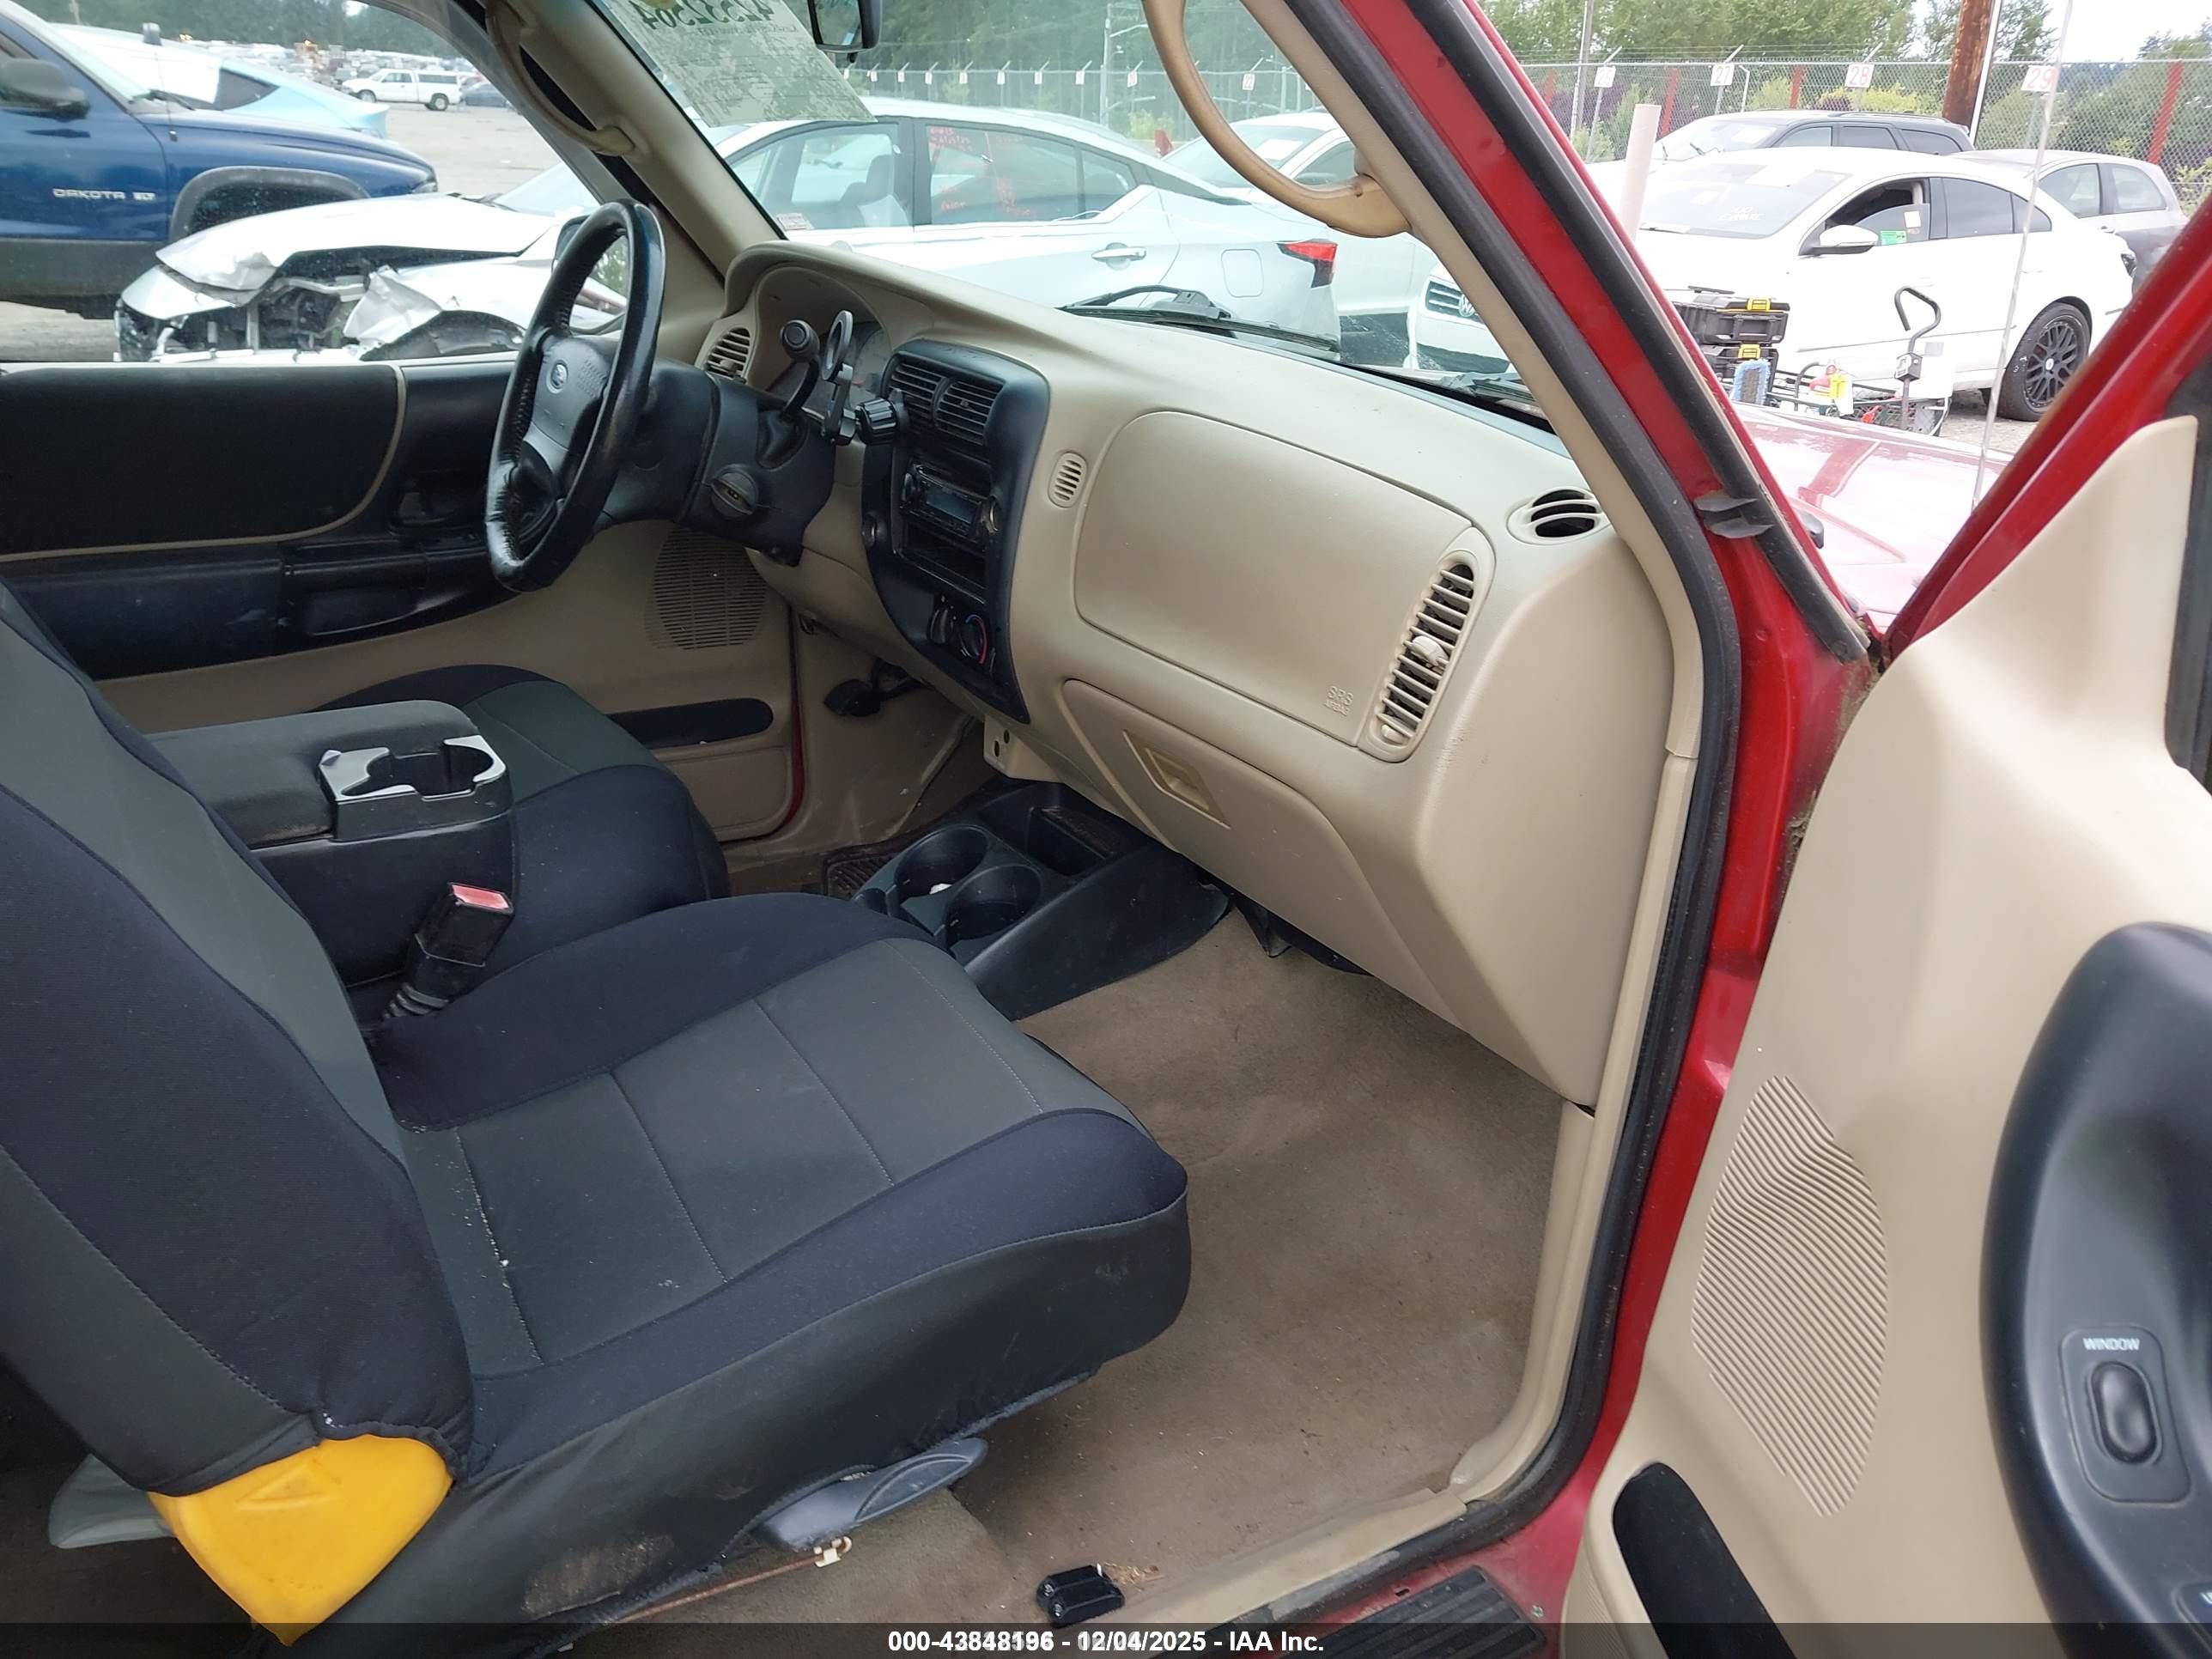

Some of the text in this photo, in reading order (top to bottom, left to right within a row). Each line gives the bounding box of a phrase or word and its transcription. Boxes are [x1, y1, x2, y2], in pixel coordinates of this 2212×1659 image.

[1713, 65, 1731, 84] 27
[1849, 65, 1870, 86] 28
[2027, 68, 2057, 90] 29
[52, 188, 126, 200] DAKOTA
[2082, 1337, 2141, 1351] WINDOW
